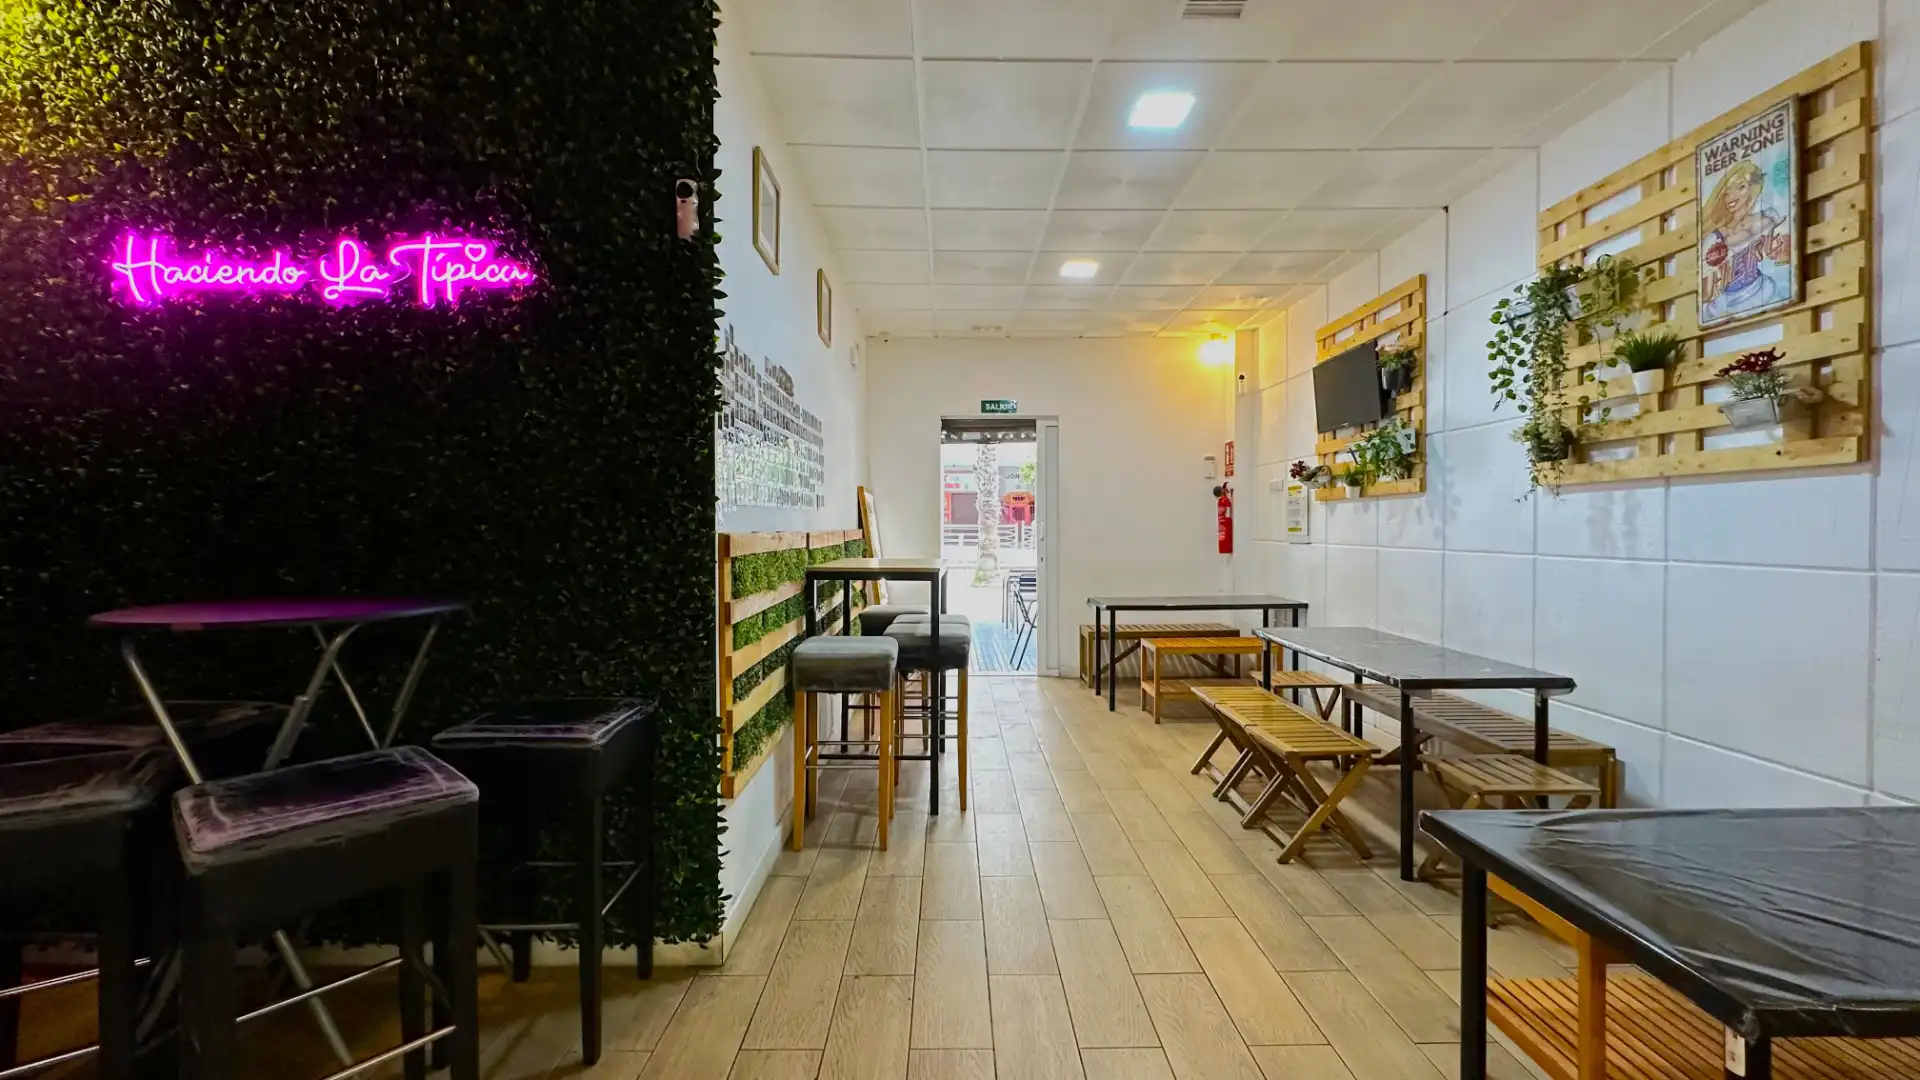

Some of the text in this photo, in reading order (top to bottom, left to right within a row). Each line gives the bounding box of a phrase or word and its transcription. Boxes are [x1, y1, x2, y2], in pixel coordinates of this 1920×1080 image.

[1704, 113, 1785, 163] WARNING
[1704, 128, 1785, 176] BEER ZONE
[112, 235, 530, 304] Haciendo La Típica
